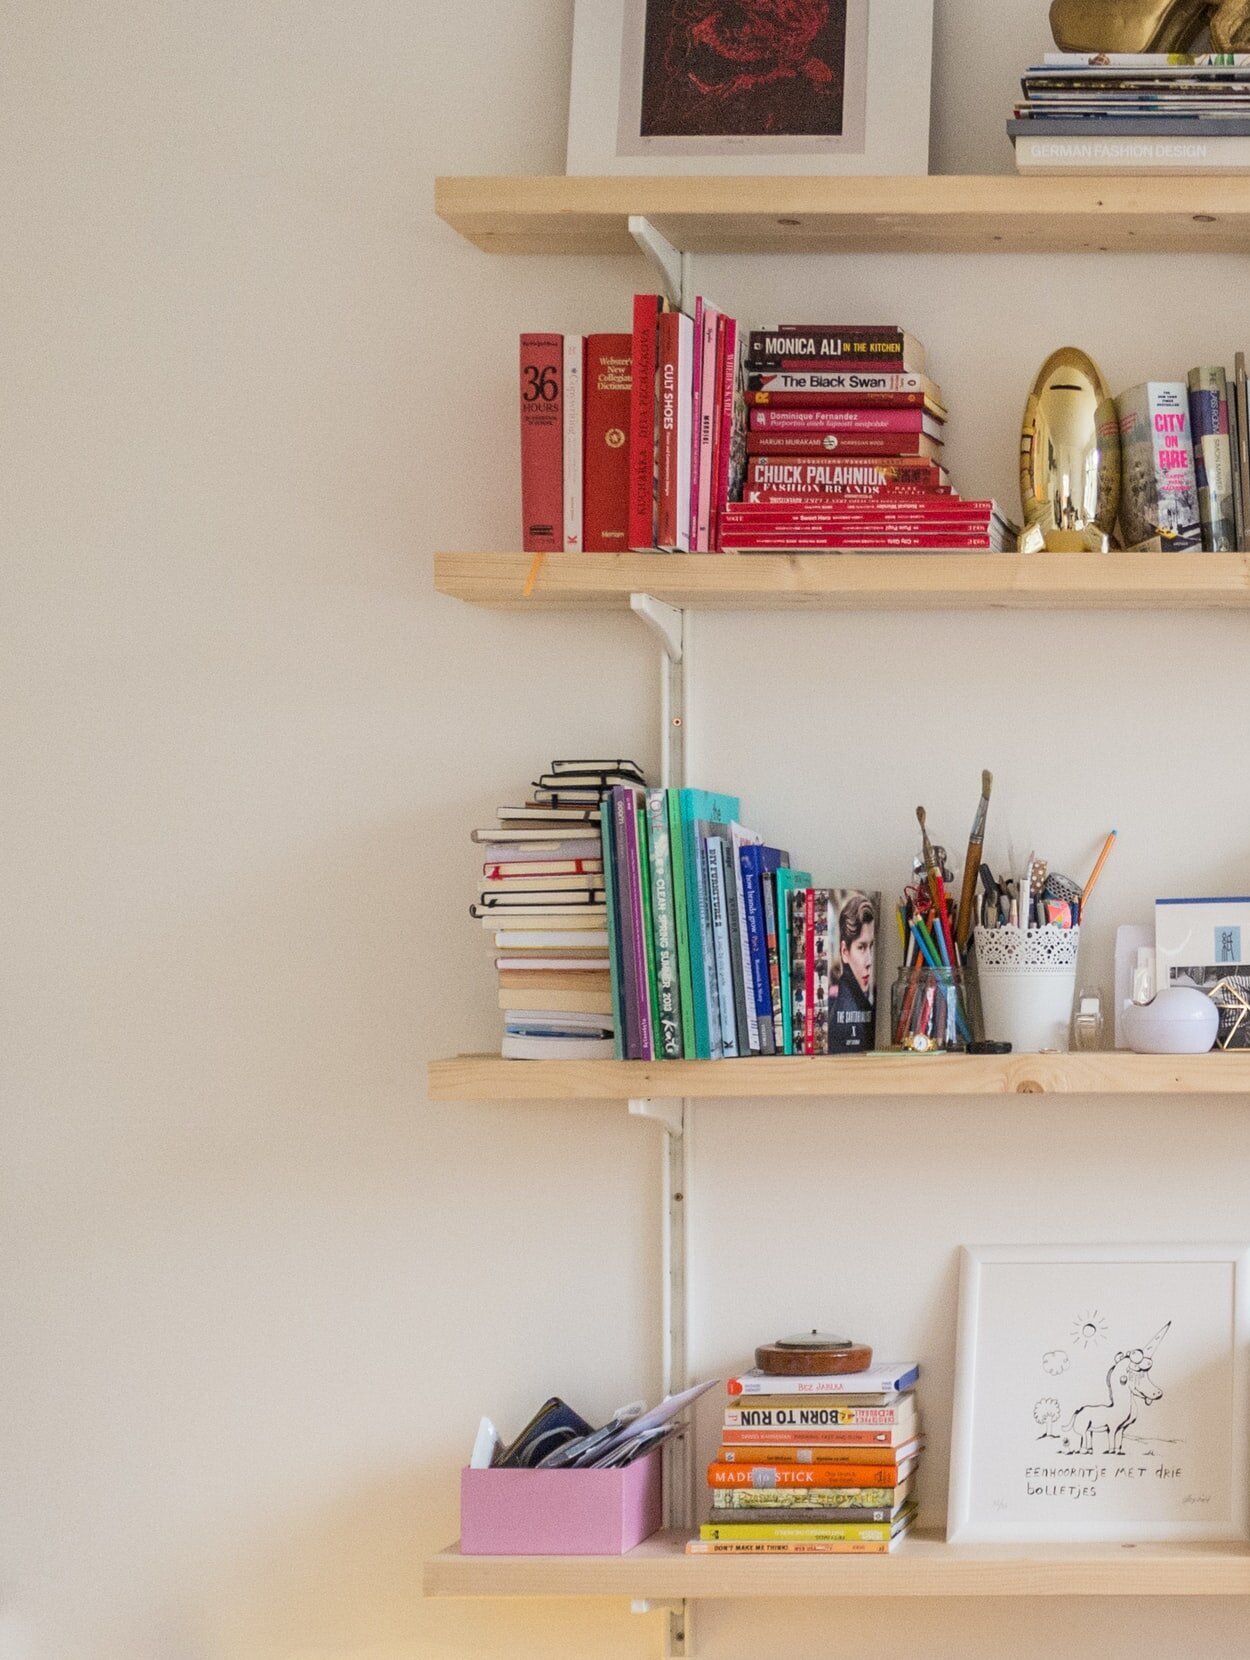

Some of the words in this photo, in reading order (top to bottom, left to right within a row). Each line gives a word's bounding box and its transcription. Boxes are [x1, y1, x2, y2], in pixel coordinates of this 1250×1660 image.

[1031, 144, 1091, 157] GERMAN
[1094, 144, 1152, 157] FASHION
[1155, 144, 1206, 157] DESIGN
[765, 338, 816, 355] MONICA
[821, 338, 842, 356] ALI
[842, 343, 851, 352] IN
[854, 343, 867, 352] THE
[869, 342, 901, 353] KITCHEN
[608, 366, 626, 374] New
[663, 364, 674, 391] CULT
[524, 365, 559, 402] 36
[781, 375, 806, 388] The
[810, 375, 846, 388] Black
[849, 375, 886, 389] Swan
[524, 403, 559, 412] HOURS
[663, 393, 674, 430] SHOES
[770, 413, 813, 422] Dominique
[815, 412, 858, 421] Fernandez
[1154, 413, 1185, 433] CITY
[1165, 435, 1178, 449] ON
[1213, 439, 1222, 463] SIMON
[1158, 450, 1188, 469] FIRE
[754, 465, 802, 484] CHUCK
[806, 466, 887, 485] PALAHNIUK
[1215, 463, 1224, 490] MAWER
[763, 484, 820, 494] FASHION
[825, 484, 880, 494] BRANDS
[709, 849, 718, 866] DIY
[745, 874, 754, 890] how
[655, 879, 667, 911] CLEAN
[711, 867, 722, 921] FURNITURE
[747, 890, 757, 915] brands
[657, 914, 669, 948] SPRING
[748, 915, 757, 934] grow
[660, 951, 671, 988] SUMMER
[663, 992, 672, 1012] 2013
[837, 1010, 845, 1023] THE
[740, 1411, 772, 1426] RUN
[775, 1410, 796, 1425] TO
[799, 1410, 839, 1425] BORN
[715, 1471, 753, 1482] MADE
[775, 1471, 814, 1482] STICK
[1114, 1467, 1148, 1478] MET
